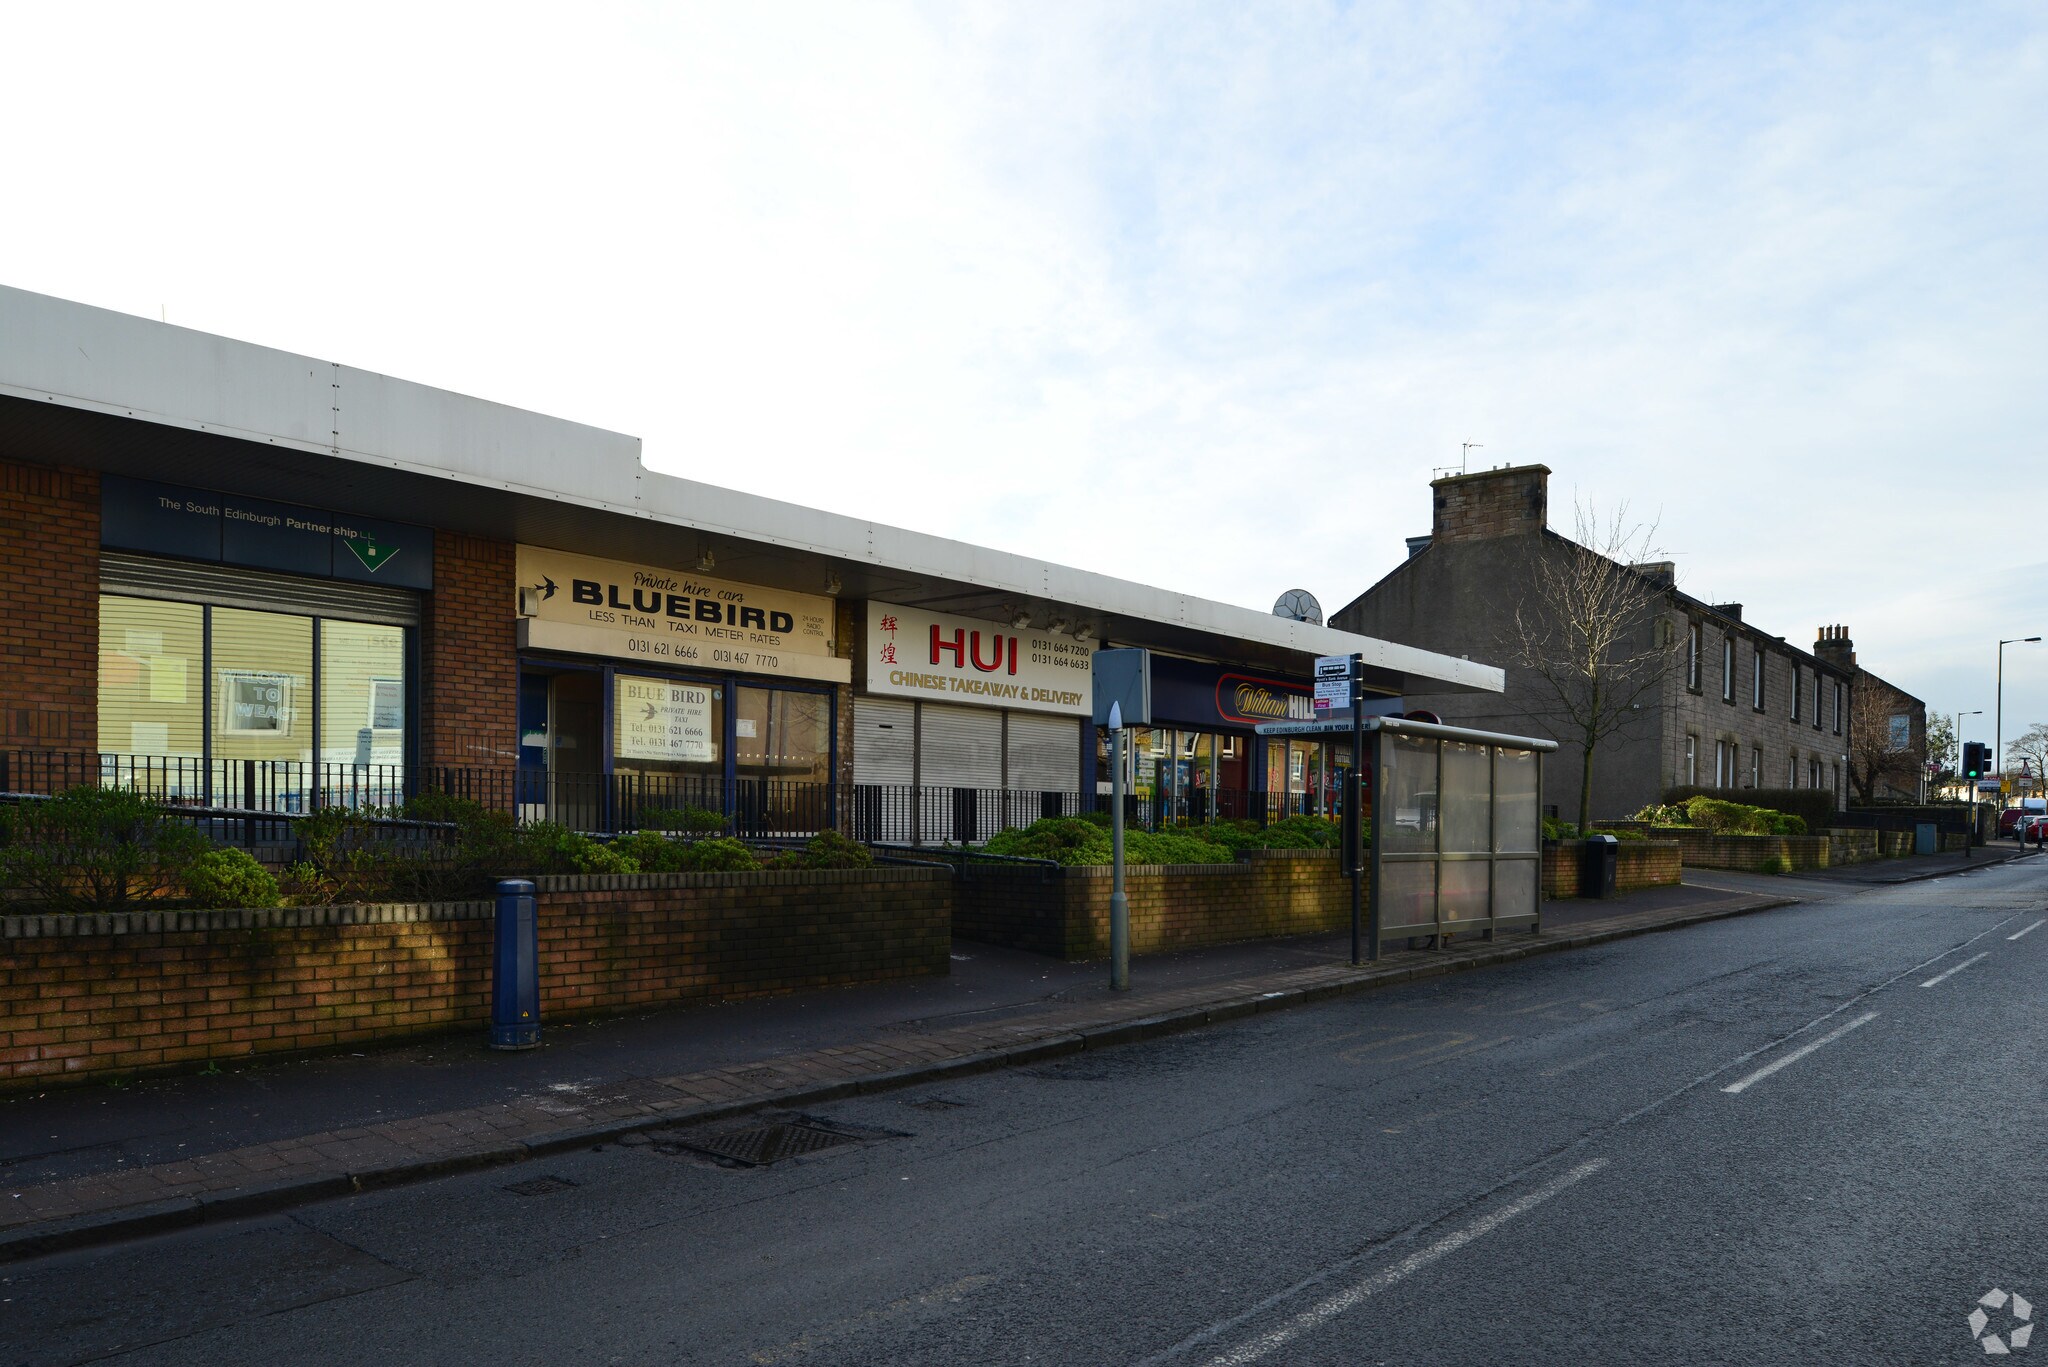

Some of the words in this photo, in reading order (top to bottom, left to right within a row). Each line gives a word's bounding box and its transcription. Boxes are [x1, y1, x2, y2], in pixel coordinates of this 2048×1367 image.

[158, 496, 181, 511] The
[186, 501, 220, 517] South
[224, 507, 281, 527] Edinburgh
[633, 571, 678, 592] Private
[682, 578, 711, 597] hire
[717, 587, 745, 603] cars
[572, 578, 795, 634] BLUEBIRD
[588, 609, 615, 624] LESS
[622, 613, 656, 629] THAN
[667, 620, 698, 635] TAXI
[705, 625, 744, 641] METER
[750, 632, 781, 646] RATES
[628, 638, 650, 654] 0131
[653, 641, 670, 656] 621
[674, 643, 699, 660] 6666
[713, 649, 732, 664] 0131
[734, 650, 750, 665] 467
[755, 653, 779, 668] 7770
[929, 624, 1018, 675] HUI
[1032, 639, 1051, 651] 0131
[1053, 642, 1069, 654] 664
[1071, 645, 1090, 657] 7200
[1032, 653, 1051, 665] 0131
[1053, 656, 1069, 668] 664
[1070, 659, 1089, 670] 6633
[253, 687, 281, 703] TO
[627, 684, 666, 701] BLUE
[671, 688, 706, 705] BIRD
[889, 670, 947, 691] CHINESE
[949, 677, 1020, 699] TAKEAWAY
[1020, 686, 1030, 700] &
[1031, 687, 1083, 706] DELIVERY
[660, 706, 686, 716] PRIVATE
[686, 708, 702, 717] HIRE
[1234, 683, 1289, 718] William
[1288, 694, 1317, 719] HILL
[674, 715, 689, 723] TAXI
[1276, 726, 1305, 734] EDINBURGH
[1306, 725, 1322, 733] CLEAN
[1334, 724, 1350, 732] YOUR
[1349, 723, 1371, 731] LER!
[630, 722, 646, 734] Tel.
[648, 724, 666, 735] 0131
[668, 726, 682, 736] 621
[684, 727, 703, 738] 6666
[630, 736, 646, 747] Tel.
[649, 737, 666, 748] 0131
[669, 738, 683, 749] 467
[685, 740, 704, 750] 7770
